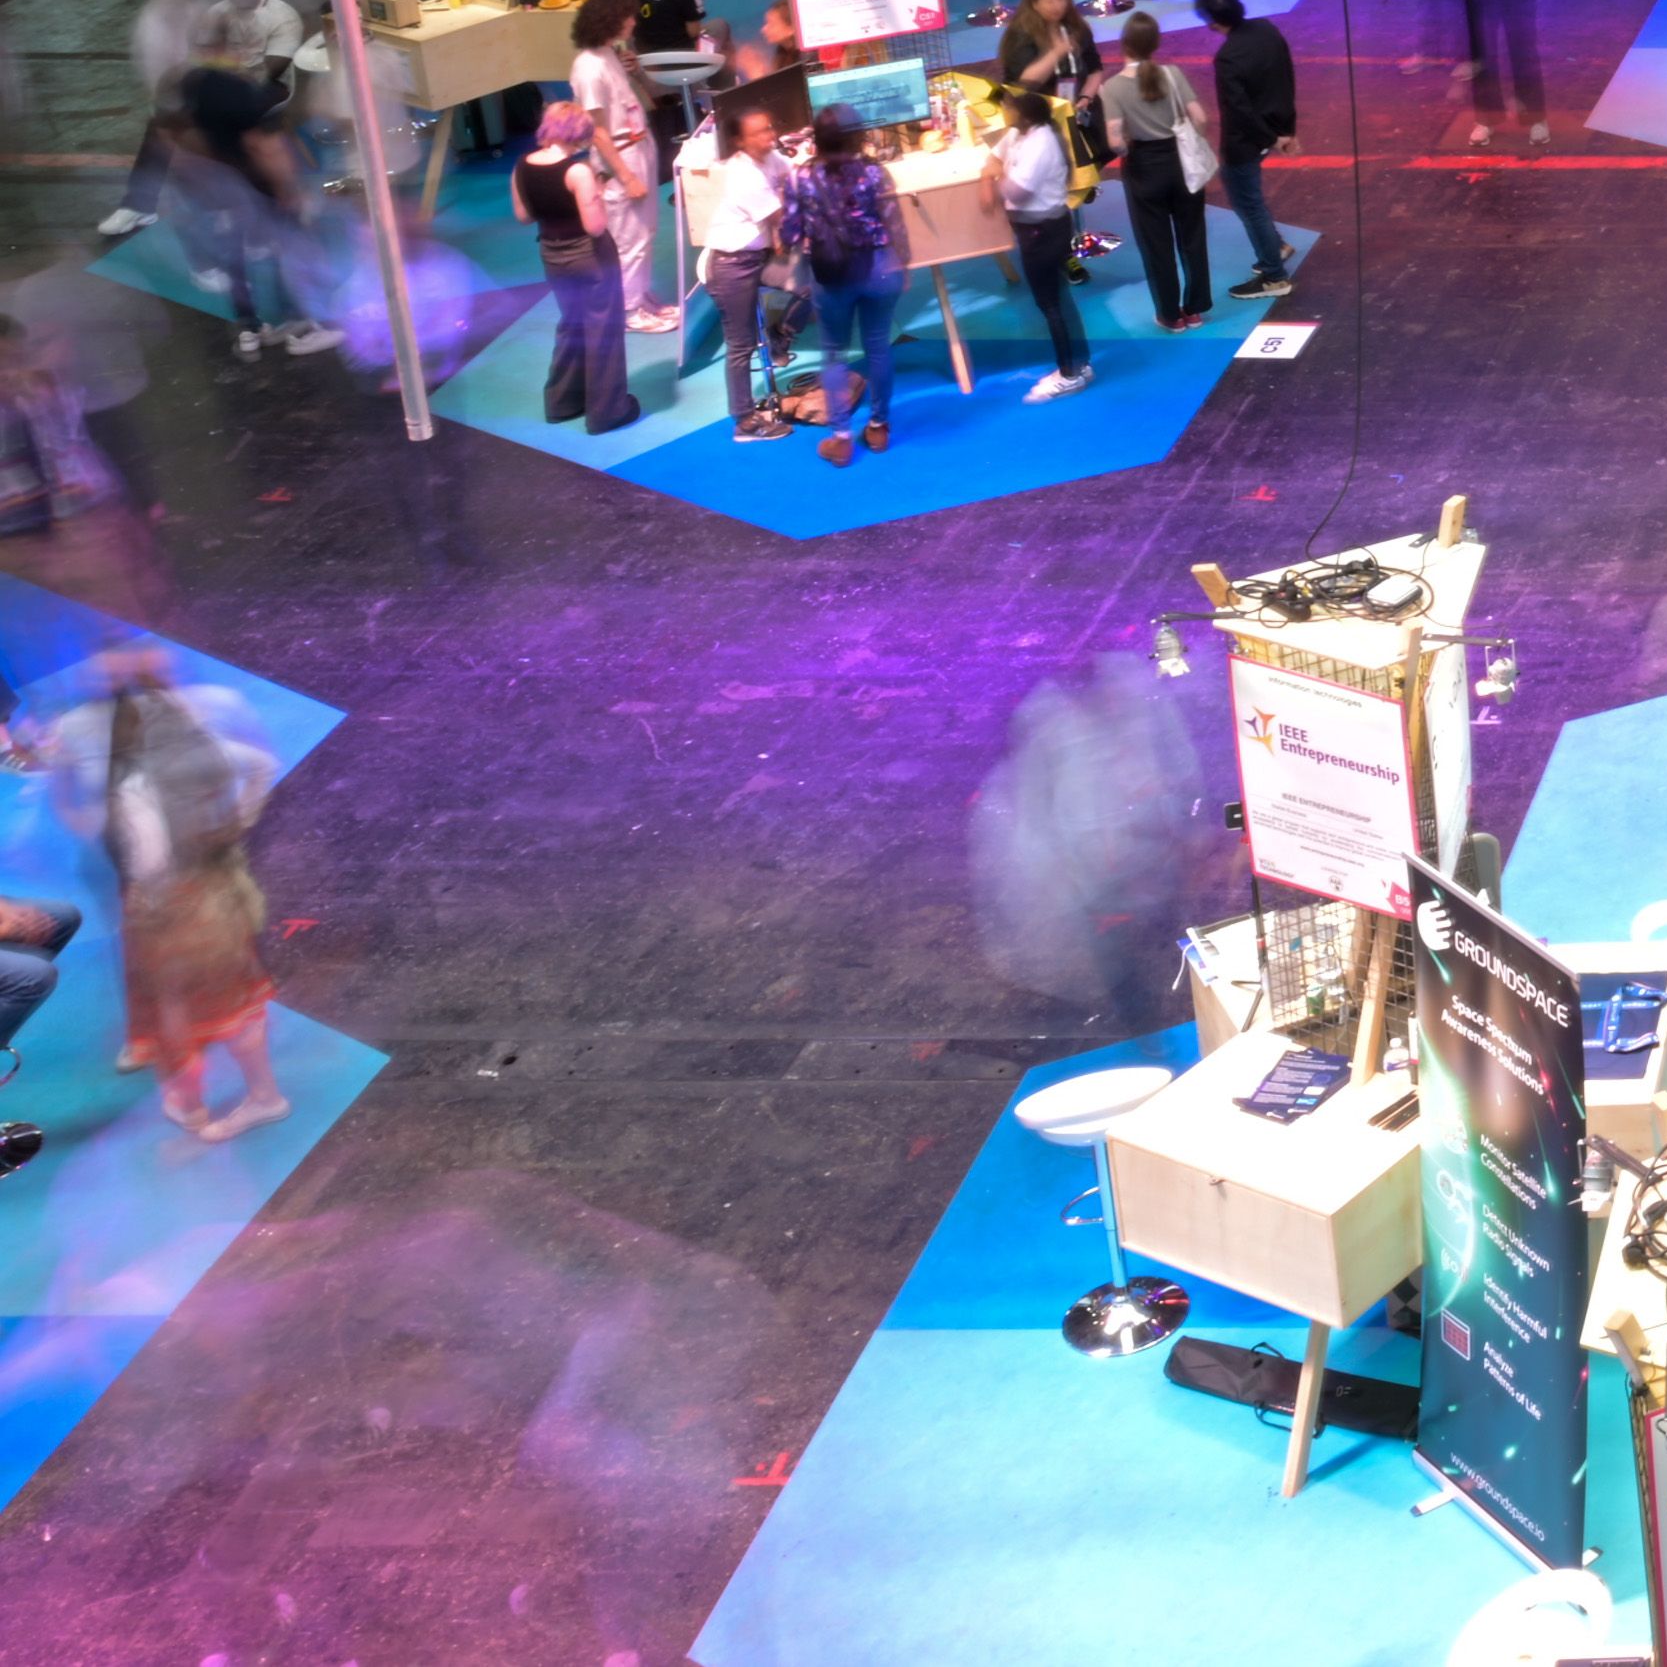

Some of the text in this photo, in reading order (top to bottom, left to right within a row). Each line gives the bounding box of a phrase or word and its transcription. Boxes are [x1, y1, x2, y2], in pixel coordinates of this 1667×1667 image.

[1260, 336, 1286, 354] C51
[1278, 722, 1310, 744] IEEE
[1279, 736, 1401, 787] Entrepreneurship
[1452, 929, 1571, 1030] GROUNDSPACE
[1440, 1008, 1545, 1096] Awareness Solutions
[1450, 994, 1534, 1067] Space Spectrum
[1479, 1133, 1548, 1201] Monitor Satellite
[1480, 1152, 1538, 1211] Constellations
[1482, 1203, 1551, 1273] Detect Unknown
[1482, 1221, 1535, 1279] Radio Signals
[1483, 1272, 1549, 1341] Identify Harmful
[1483, 1290, 1532, 1345] Interference
[1483, 1341, 1516, 1380] Analyze
[1483, 1357, 1517, 1398] Patterns
[1525, 1397, 1543, 1422] Life
[1449, 1451, 1547, 1544] www.groundspace.io
